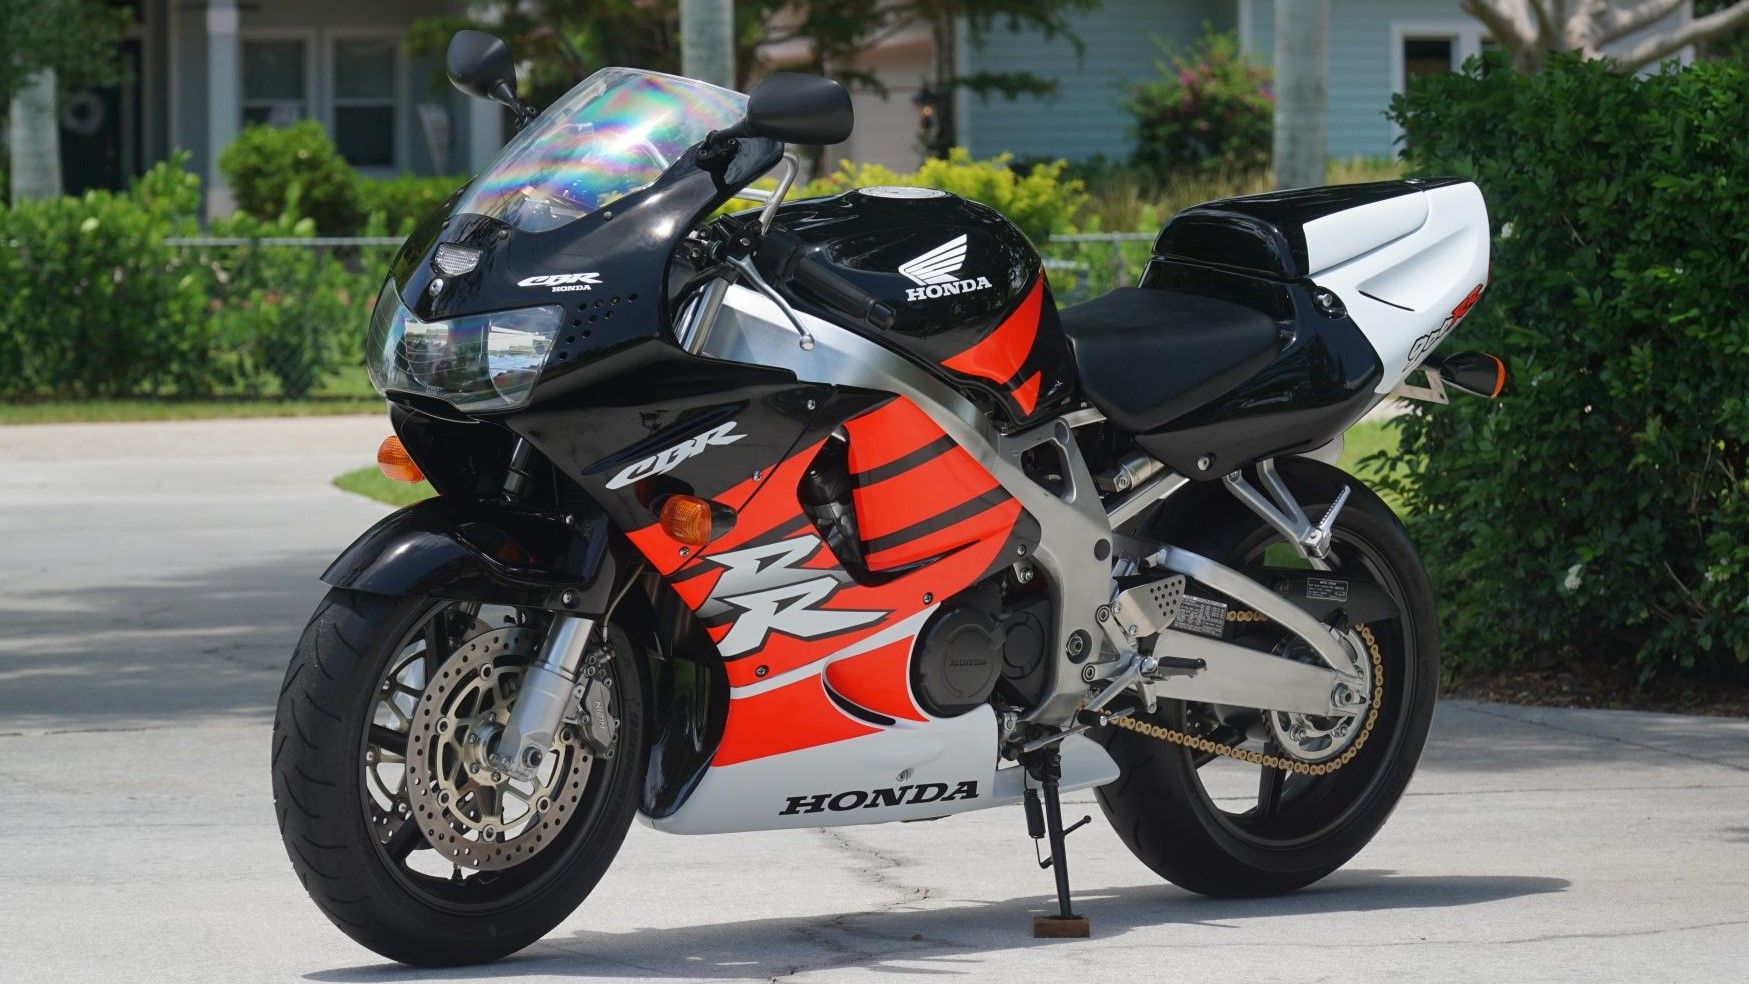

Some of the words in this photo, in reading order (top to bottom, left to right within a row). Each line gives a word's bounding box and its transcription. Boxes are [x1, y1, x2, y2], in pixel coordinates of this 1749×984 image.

[517, 272, 604, 287] CBR
[551, 284, 592, 293] HONDA
[905, 276, 993, 302] HONDA
[605, 421, 748, 490] CBR
[778, 780, 980, 816] HONDA
